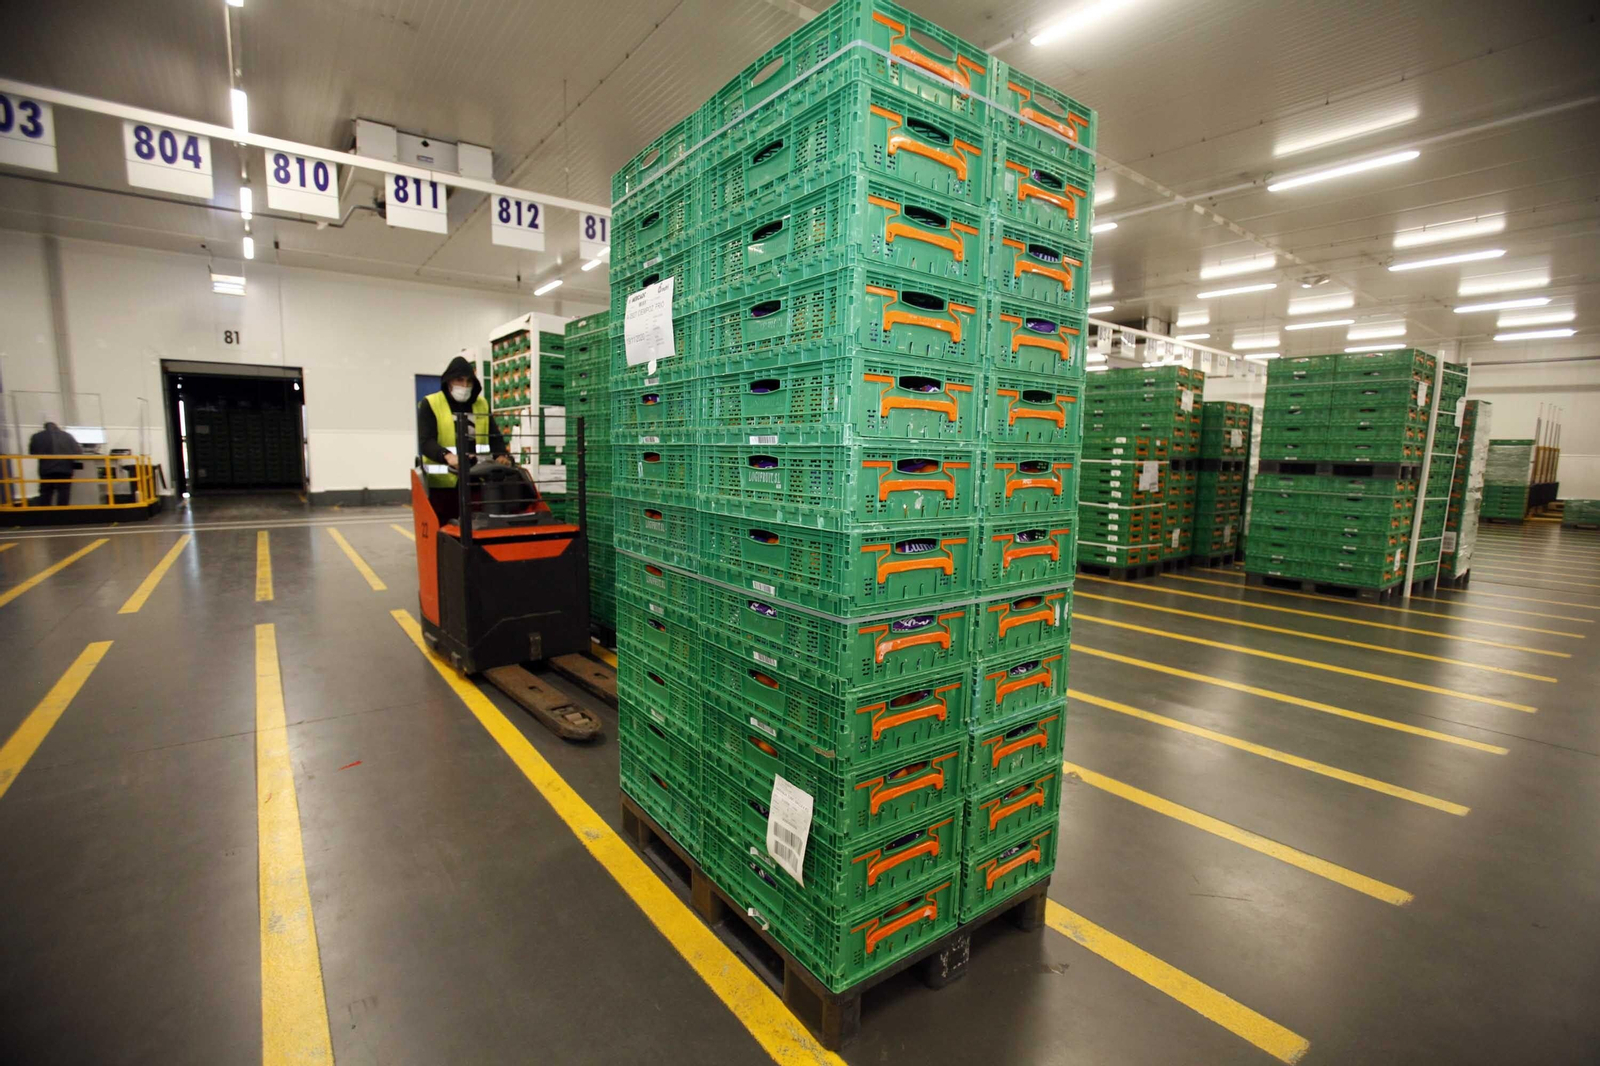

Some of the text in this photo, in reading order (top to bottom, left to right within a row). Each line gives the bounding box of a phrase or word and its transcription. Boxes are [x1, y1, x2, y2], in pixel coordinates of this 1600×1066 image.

[133, 125, 202, 169] 804
[273, 153, 329, 192] 810
[394, 174, 438, 209] 811
[498, 197, 539, 229] 812
[223, 329, 240, 345] 81
